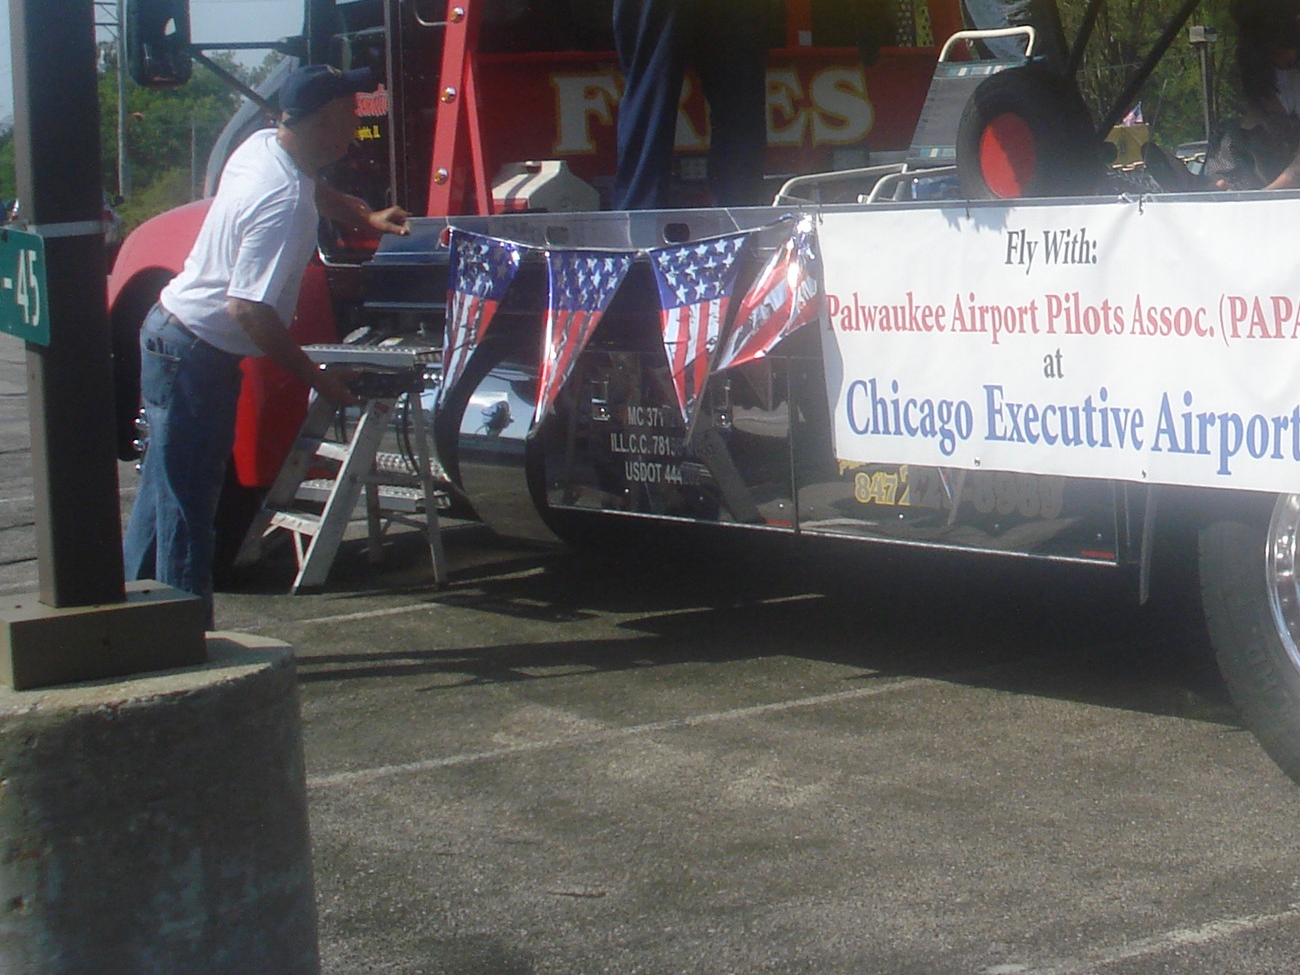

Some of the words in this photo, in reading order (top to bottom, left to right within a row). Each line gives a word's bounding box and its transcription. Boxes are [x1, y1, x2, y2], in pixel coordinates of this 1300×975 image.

[551, 65, 875, 155] FES
[1005, 227, 1038, 275] Fly
[1043, 227, 1098, 265] With:
[826, 291, 946, 333] Palwaukee
[951, 291, 1039, 346] Airport
[1045, 291, 1125, 337] Pilots
[1129, 293, 1215, 338] Assoc.
[1043, 348, 1064, 379] at
[627, 406, 644, 426] MC
[846, 377, 974, 456] Chicago
[983, 384, 1145, 452] Executive
[625, 461, 662, 483] USDOT
[855, 471, 899, 506] 847
